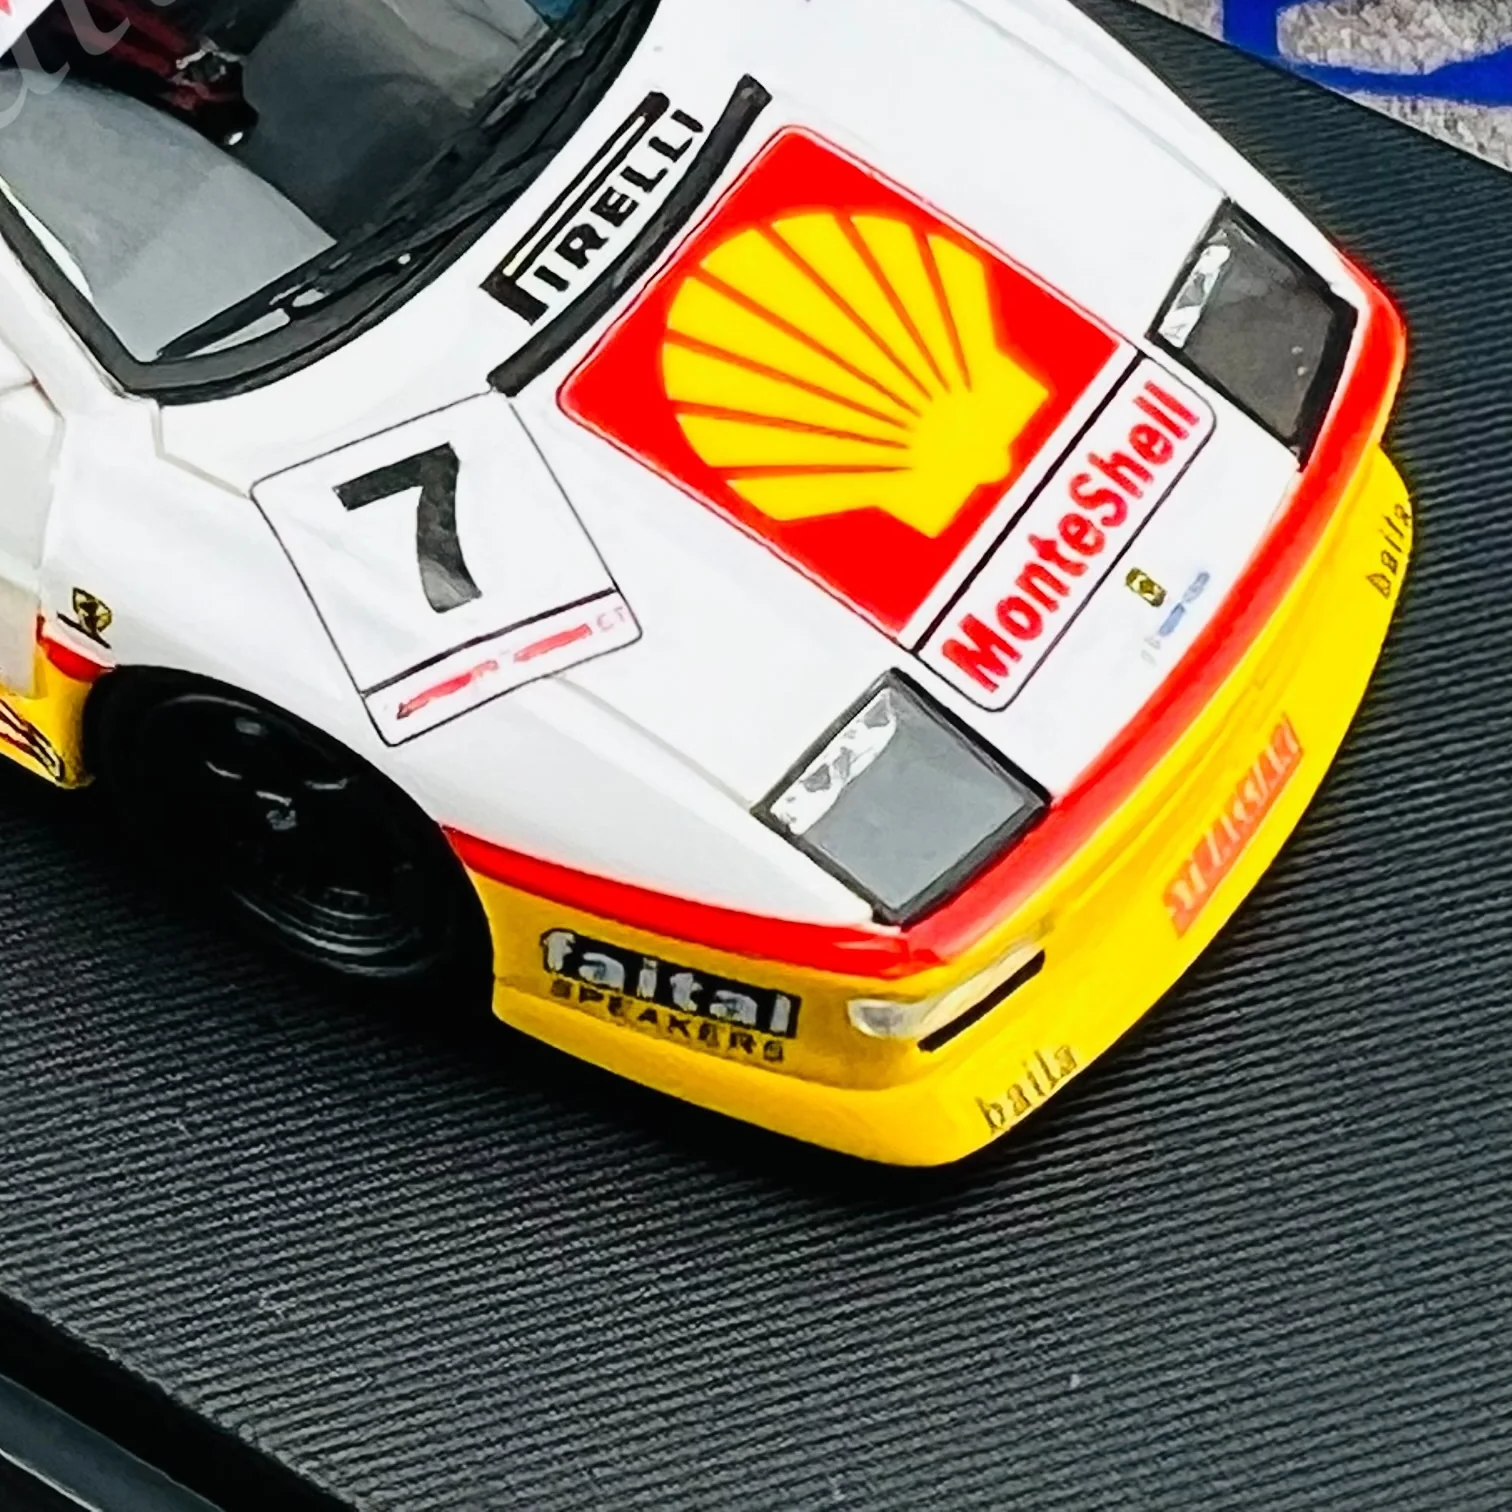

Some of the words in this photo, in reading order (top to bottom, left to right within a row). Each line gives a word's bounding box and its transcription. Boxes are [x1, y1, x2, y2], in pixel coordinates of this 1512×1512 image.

[480, 91, 704, 326] PIRELLI
[332, 441, 483, 614] 7
[941, 380, 1200, 693] MonteShell
